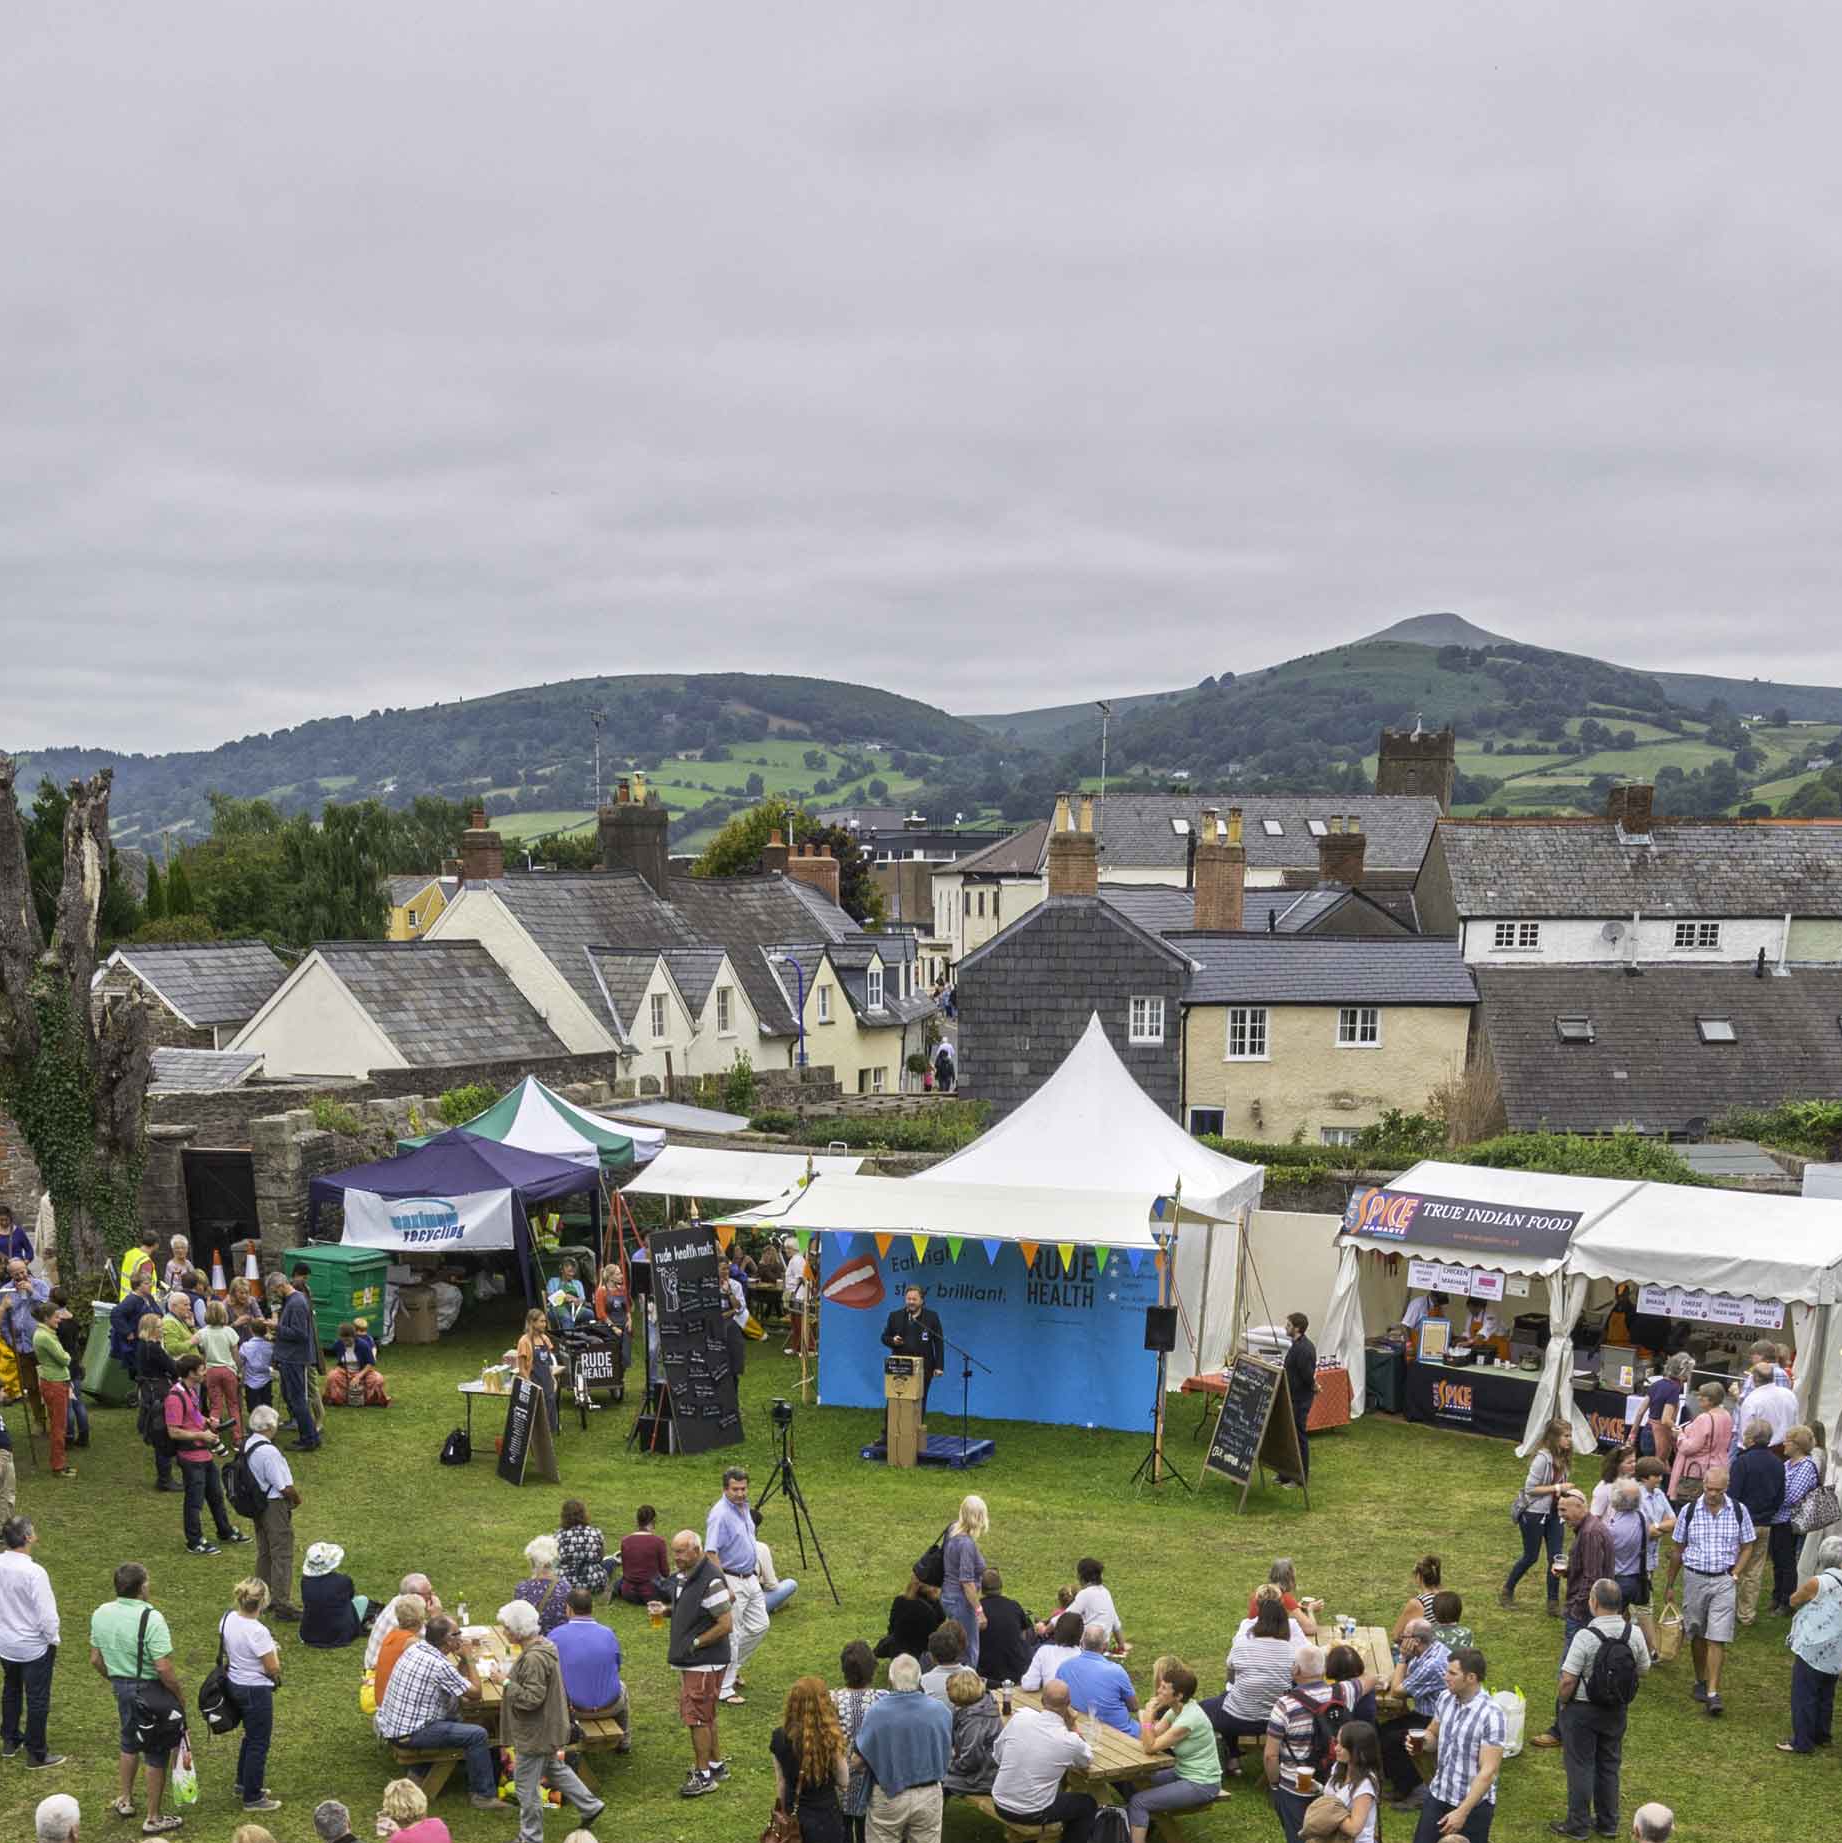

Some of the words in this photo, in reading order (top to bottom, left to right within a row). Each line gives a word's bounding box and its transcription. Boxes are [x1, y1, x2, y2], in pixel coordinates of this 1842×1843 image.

[1352, 1187, 1418, 1234] SPICE
[1422, 1202, 1464, 1220] TRUE
[1465, 1208, 1523, 1228] INDIAN
[1526, 1216, 1573, 1232] FOOD
[403, 1224, 466, 1242] recycling
[655, 1247, 672, 1264] rude
[674, 1243, 697, 1260] health
[1027, 1249, 1094, 1283] RUDE
[1027, 1282, 1094, 1309] HEALTH
[581, 1351, 613, 1367] RUDE
[581, 1367, 613, 1379] HEALTH
